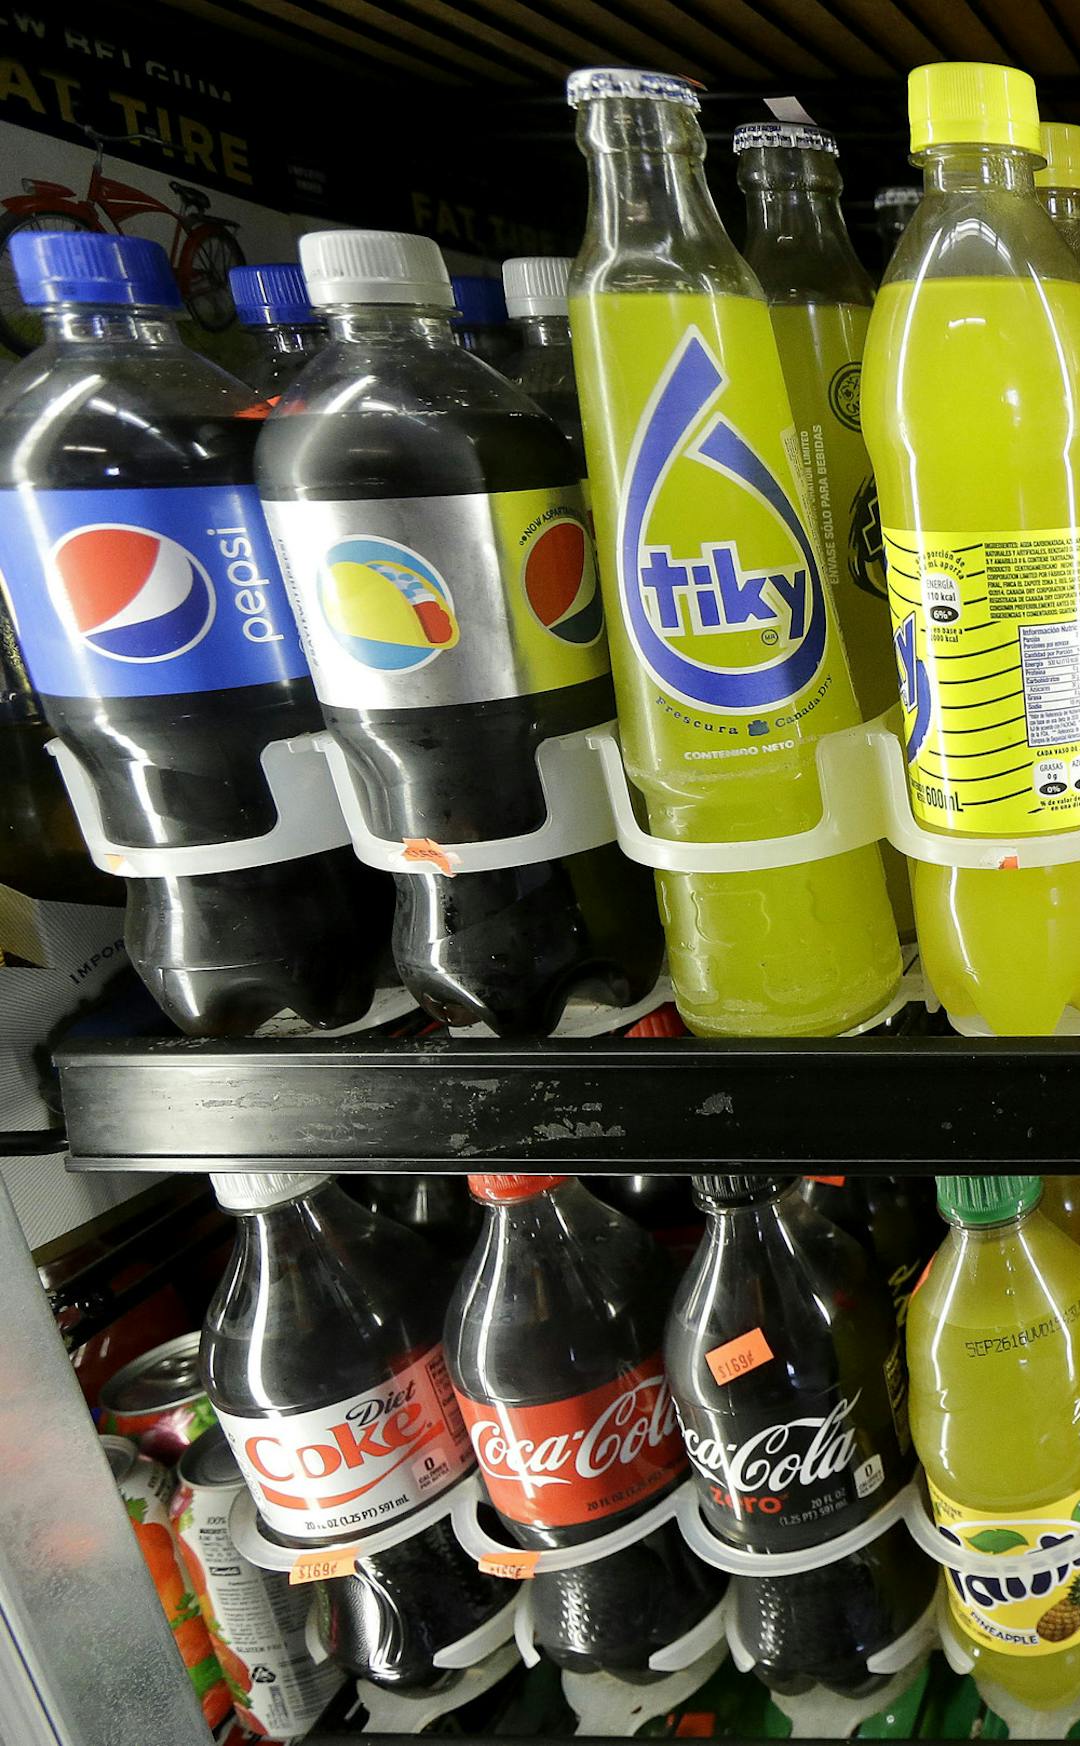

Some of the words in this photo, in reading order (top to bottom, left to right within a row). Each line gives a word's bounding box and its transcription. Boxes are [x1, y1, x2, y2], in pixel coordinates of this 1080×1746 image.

[0, 57, 80, 125] AT
[109, 91, 254, 186] TIRE
[812, 424, 827, 475] BEBIDAS
[818, 477, 831, 508] PARA
[825, 541, 839, 584] ENVASE
[208, 527, 285, 644] pepsi
[641, 547, 808, 641] tiky
[941, 592, 956, 602] kcal
[656, 696, 739, 735] Frescura
[774, 697, 821, 729] Canada
[817, 674, 833, 698] Dry
[762, 739, 795, 754] NETO
[1037, 749, 1053, 757] CADA
[1054, 747, 1070, 755] VASO
[1040, 763, 1063, 772] GRASAS
[68, 938, 126, 985] IMPOR
[345, 1379, 417, 1428] Diet
[244, 1402, 428, 1483] Coke
[424, 1457, 435, 1471] 0
[326, 1518, 340, 1529] OZ
[340, 1513, 361, 1527] (1.25
[361, 1507, 378, 1520] PT)
[378, 1501, 395, 1514] 591
[395, 1493, 410, 1507] mL
[970, 1610, 1040, 1646] PINEAPPLE
